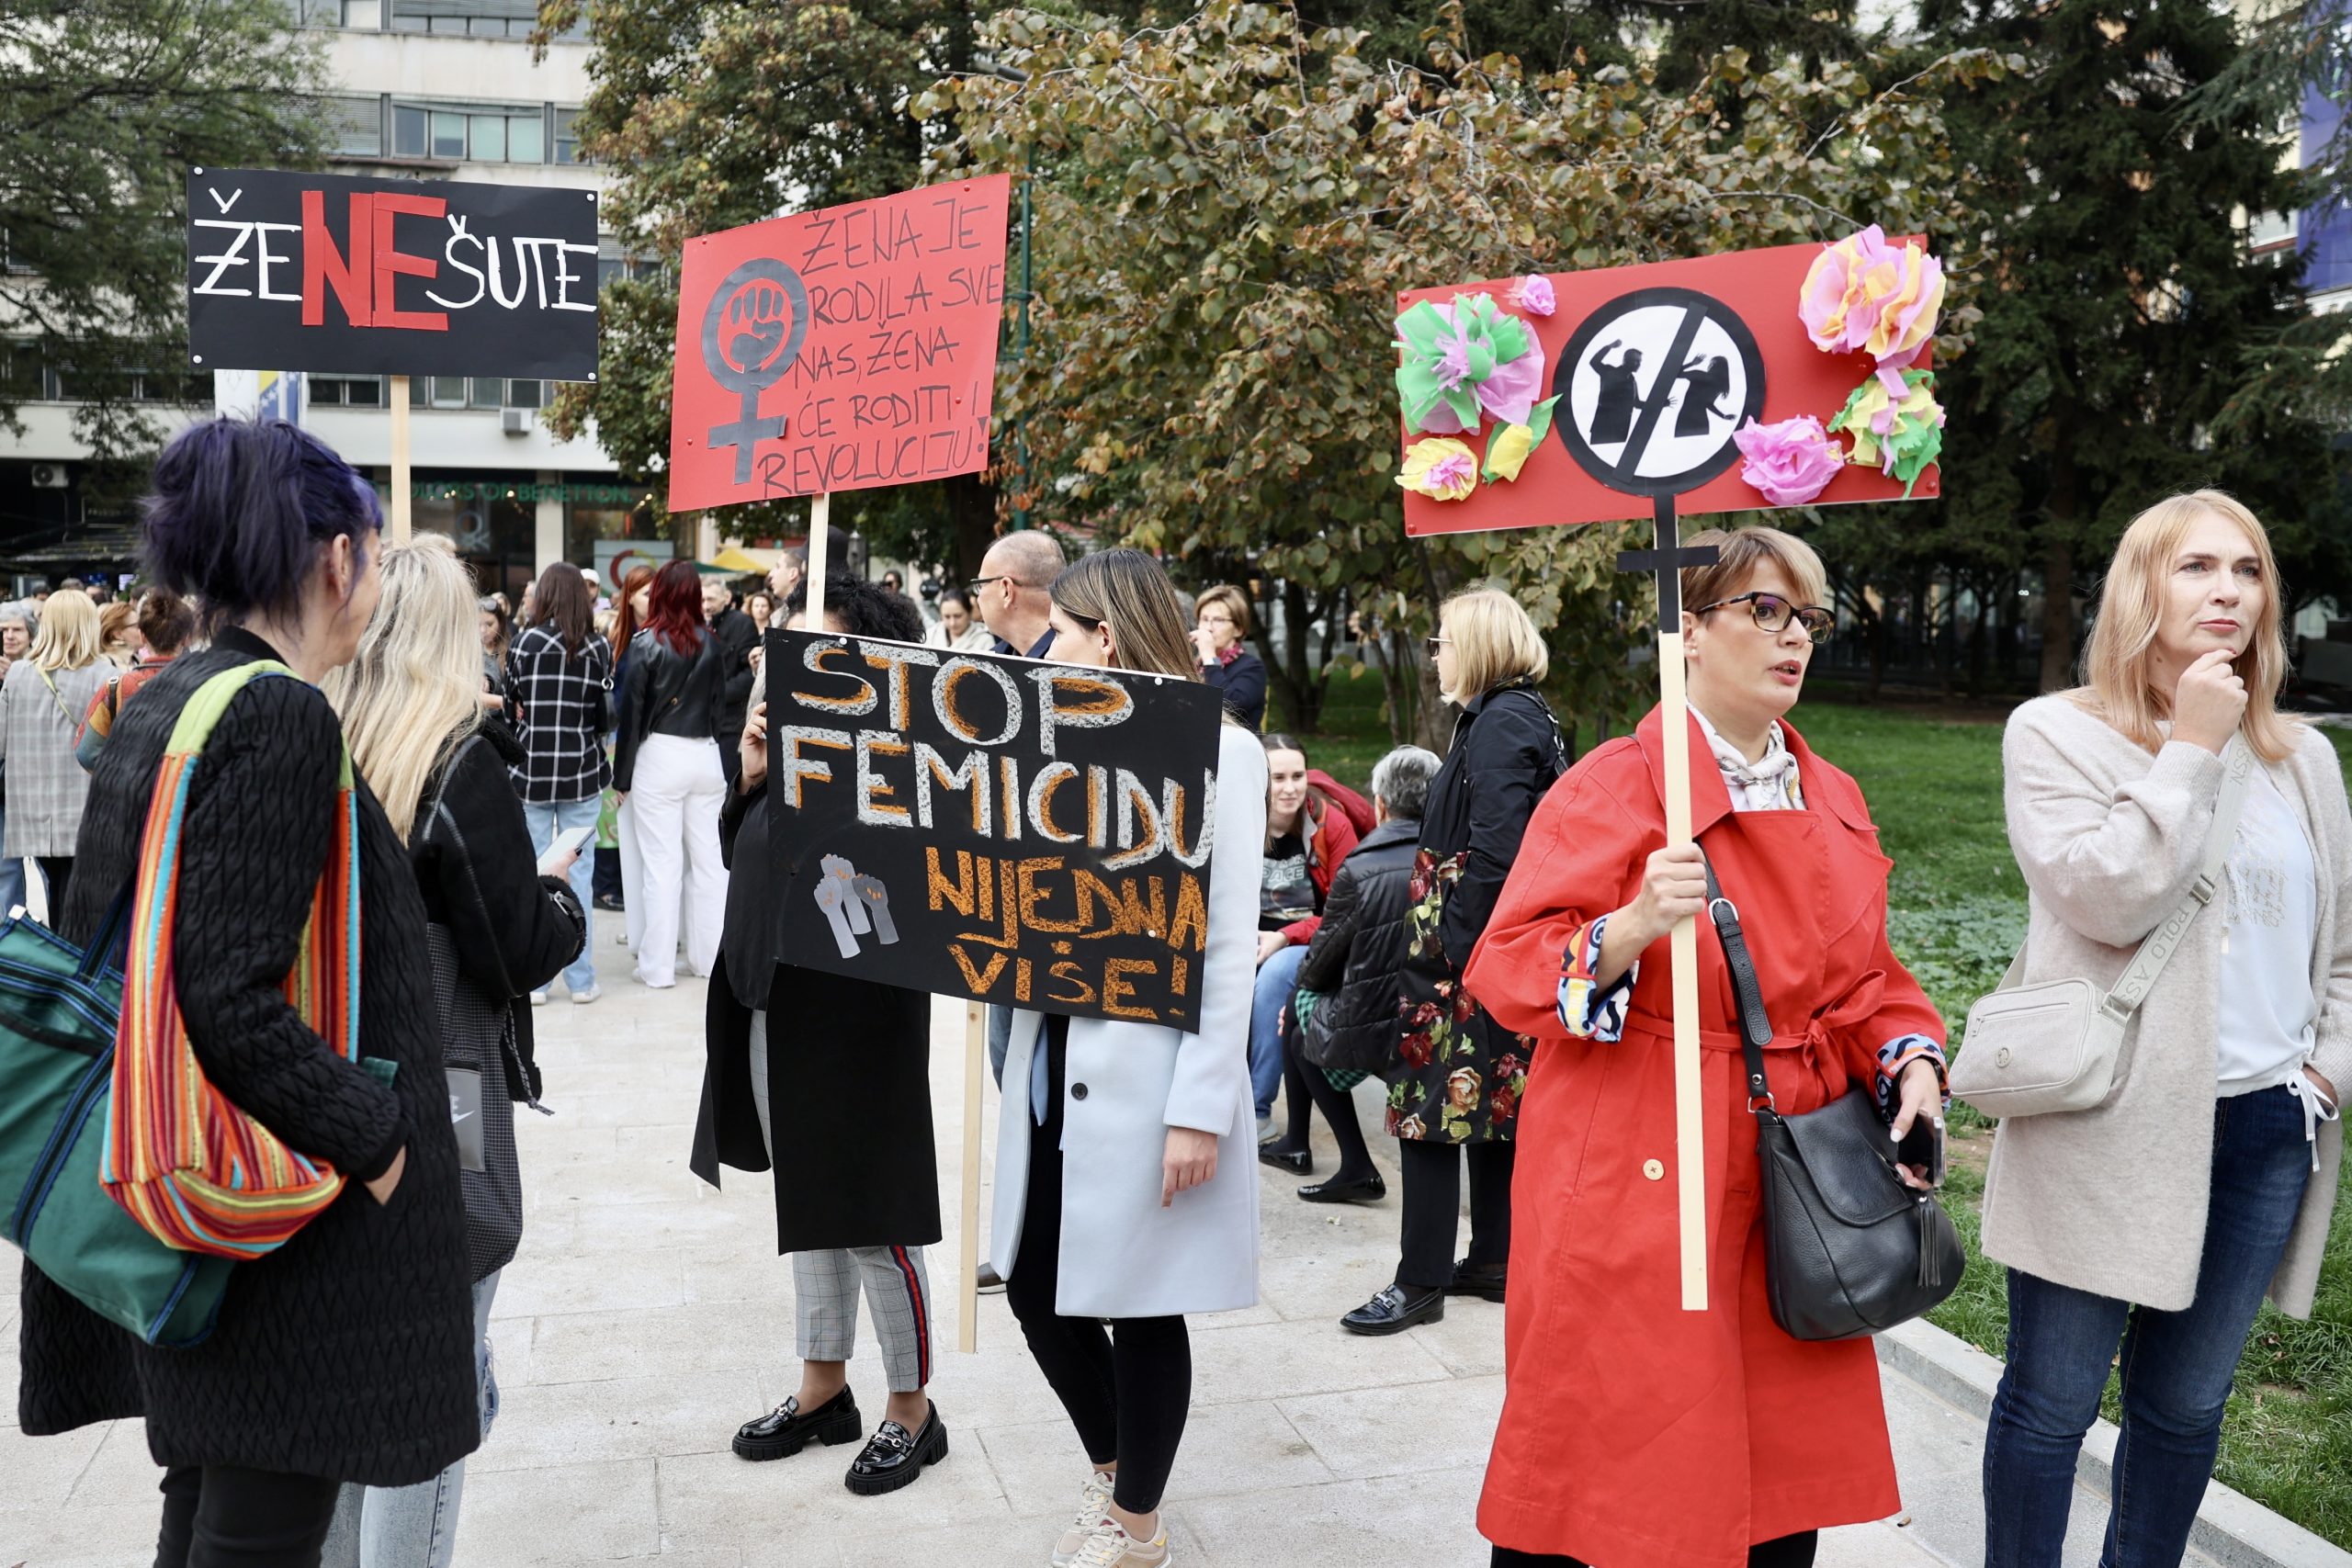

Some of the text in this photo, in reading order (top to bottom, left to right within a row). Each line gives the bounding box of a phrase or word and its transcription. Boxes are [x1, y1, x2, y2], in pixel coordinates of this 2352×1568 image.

[800, 198, 989, 276] ŽENA JE
[808, 264, 1001, 329] RODILA SVE
[795, 320, 959, 389] NAS, ŽENA
[797, 390, 837, 438] ĆE
[849, 385, 952, 429] RODITI
[791, 639, 1135, 756] STOP
[780, 726, 1217, 871] FEMICIDU
[926, 847, 1206, 952] NIJEDNA
[2151, 907, 2190, 960] POLO
[947, 941, 1188, 1021] VIŠE!
